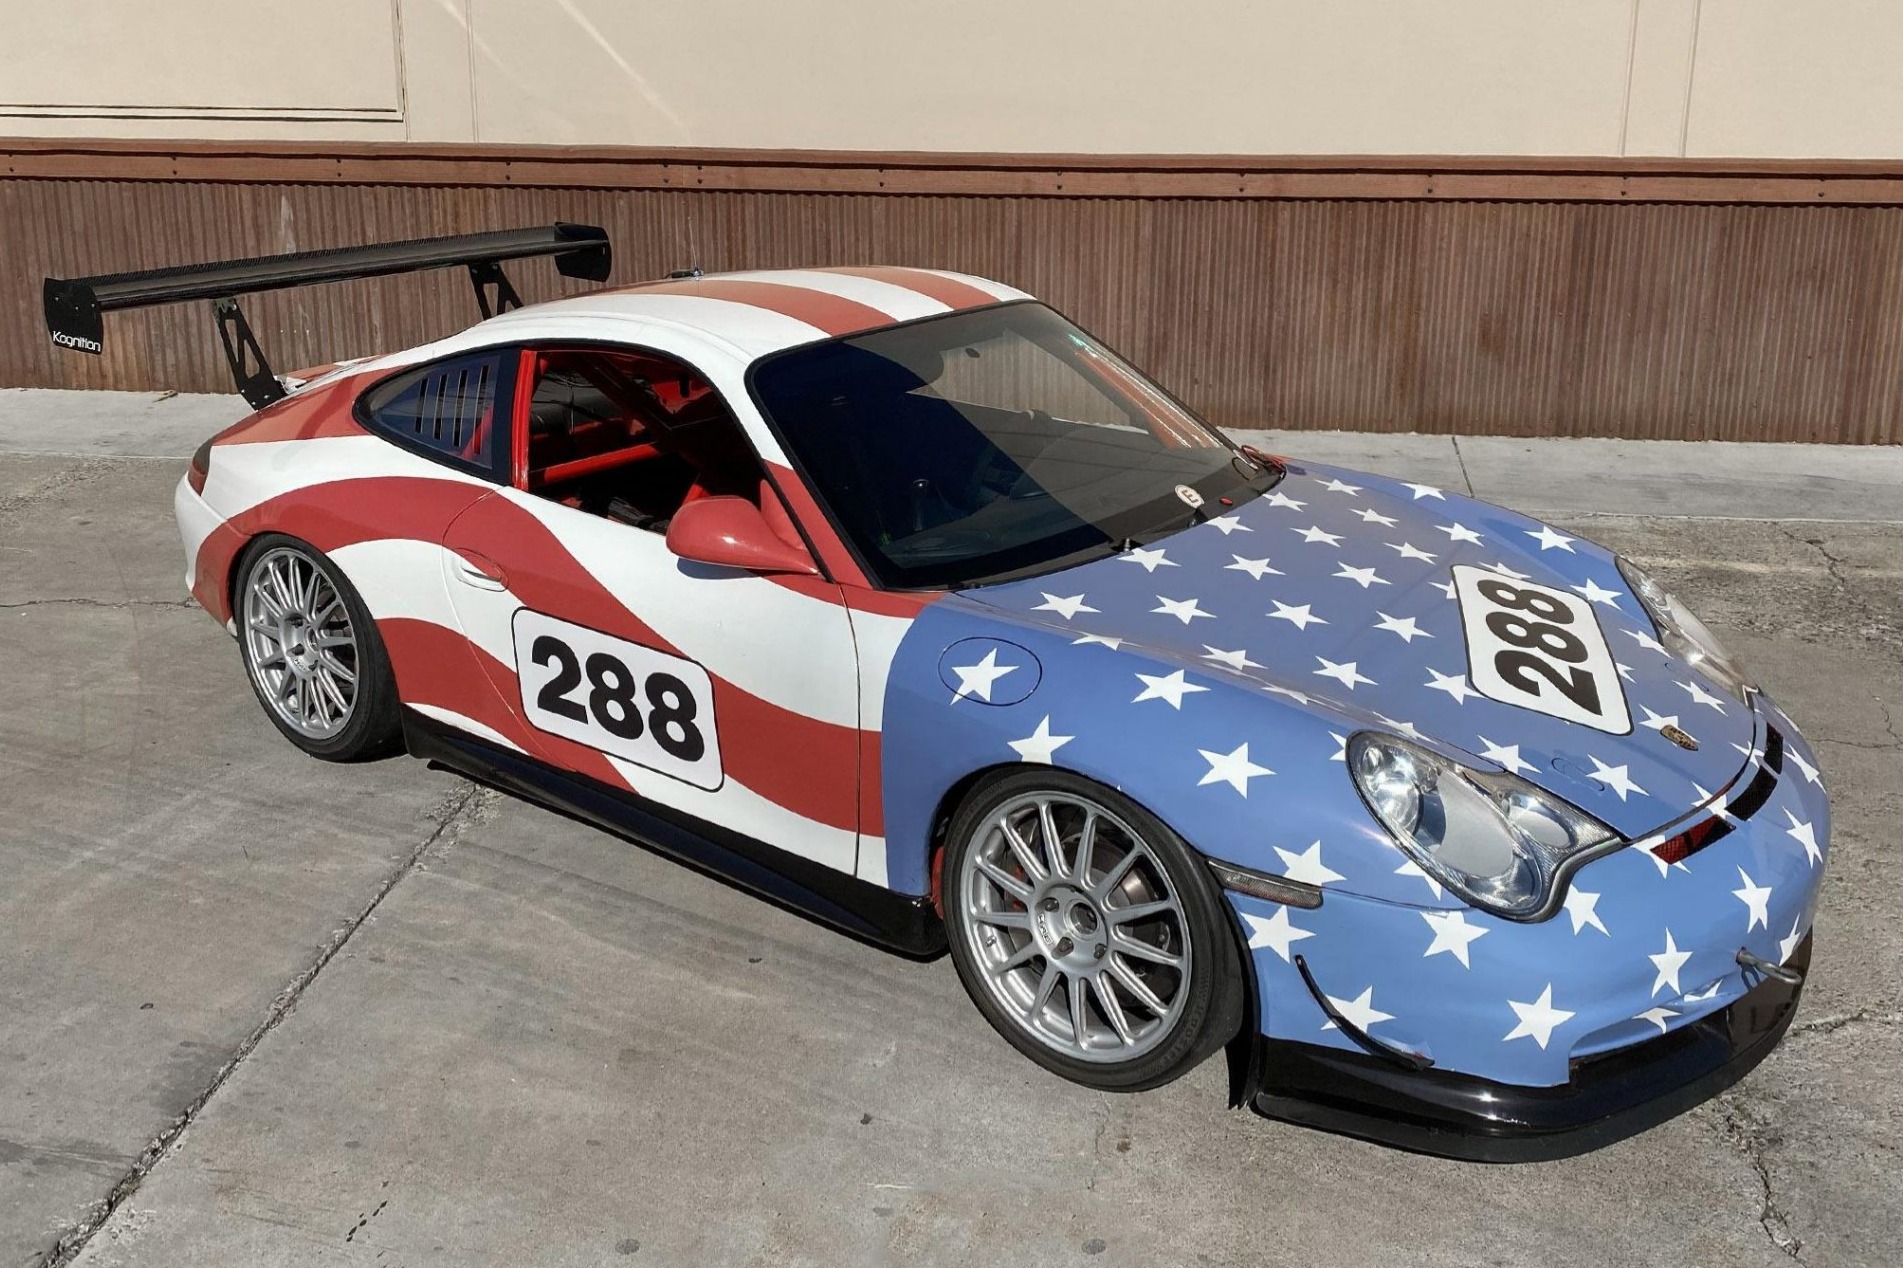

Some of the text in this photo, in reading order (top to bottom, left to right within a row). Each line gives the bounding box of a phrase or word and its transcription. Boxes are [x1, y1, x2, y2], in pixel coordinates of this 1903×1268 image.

[52, 330, 101, 352] Kognition
[531, 635, 705, 762] 288
[1477, 579, 1603, 717] 288
